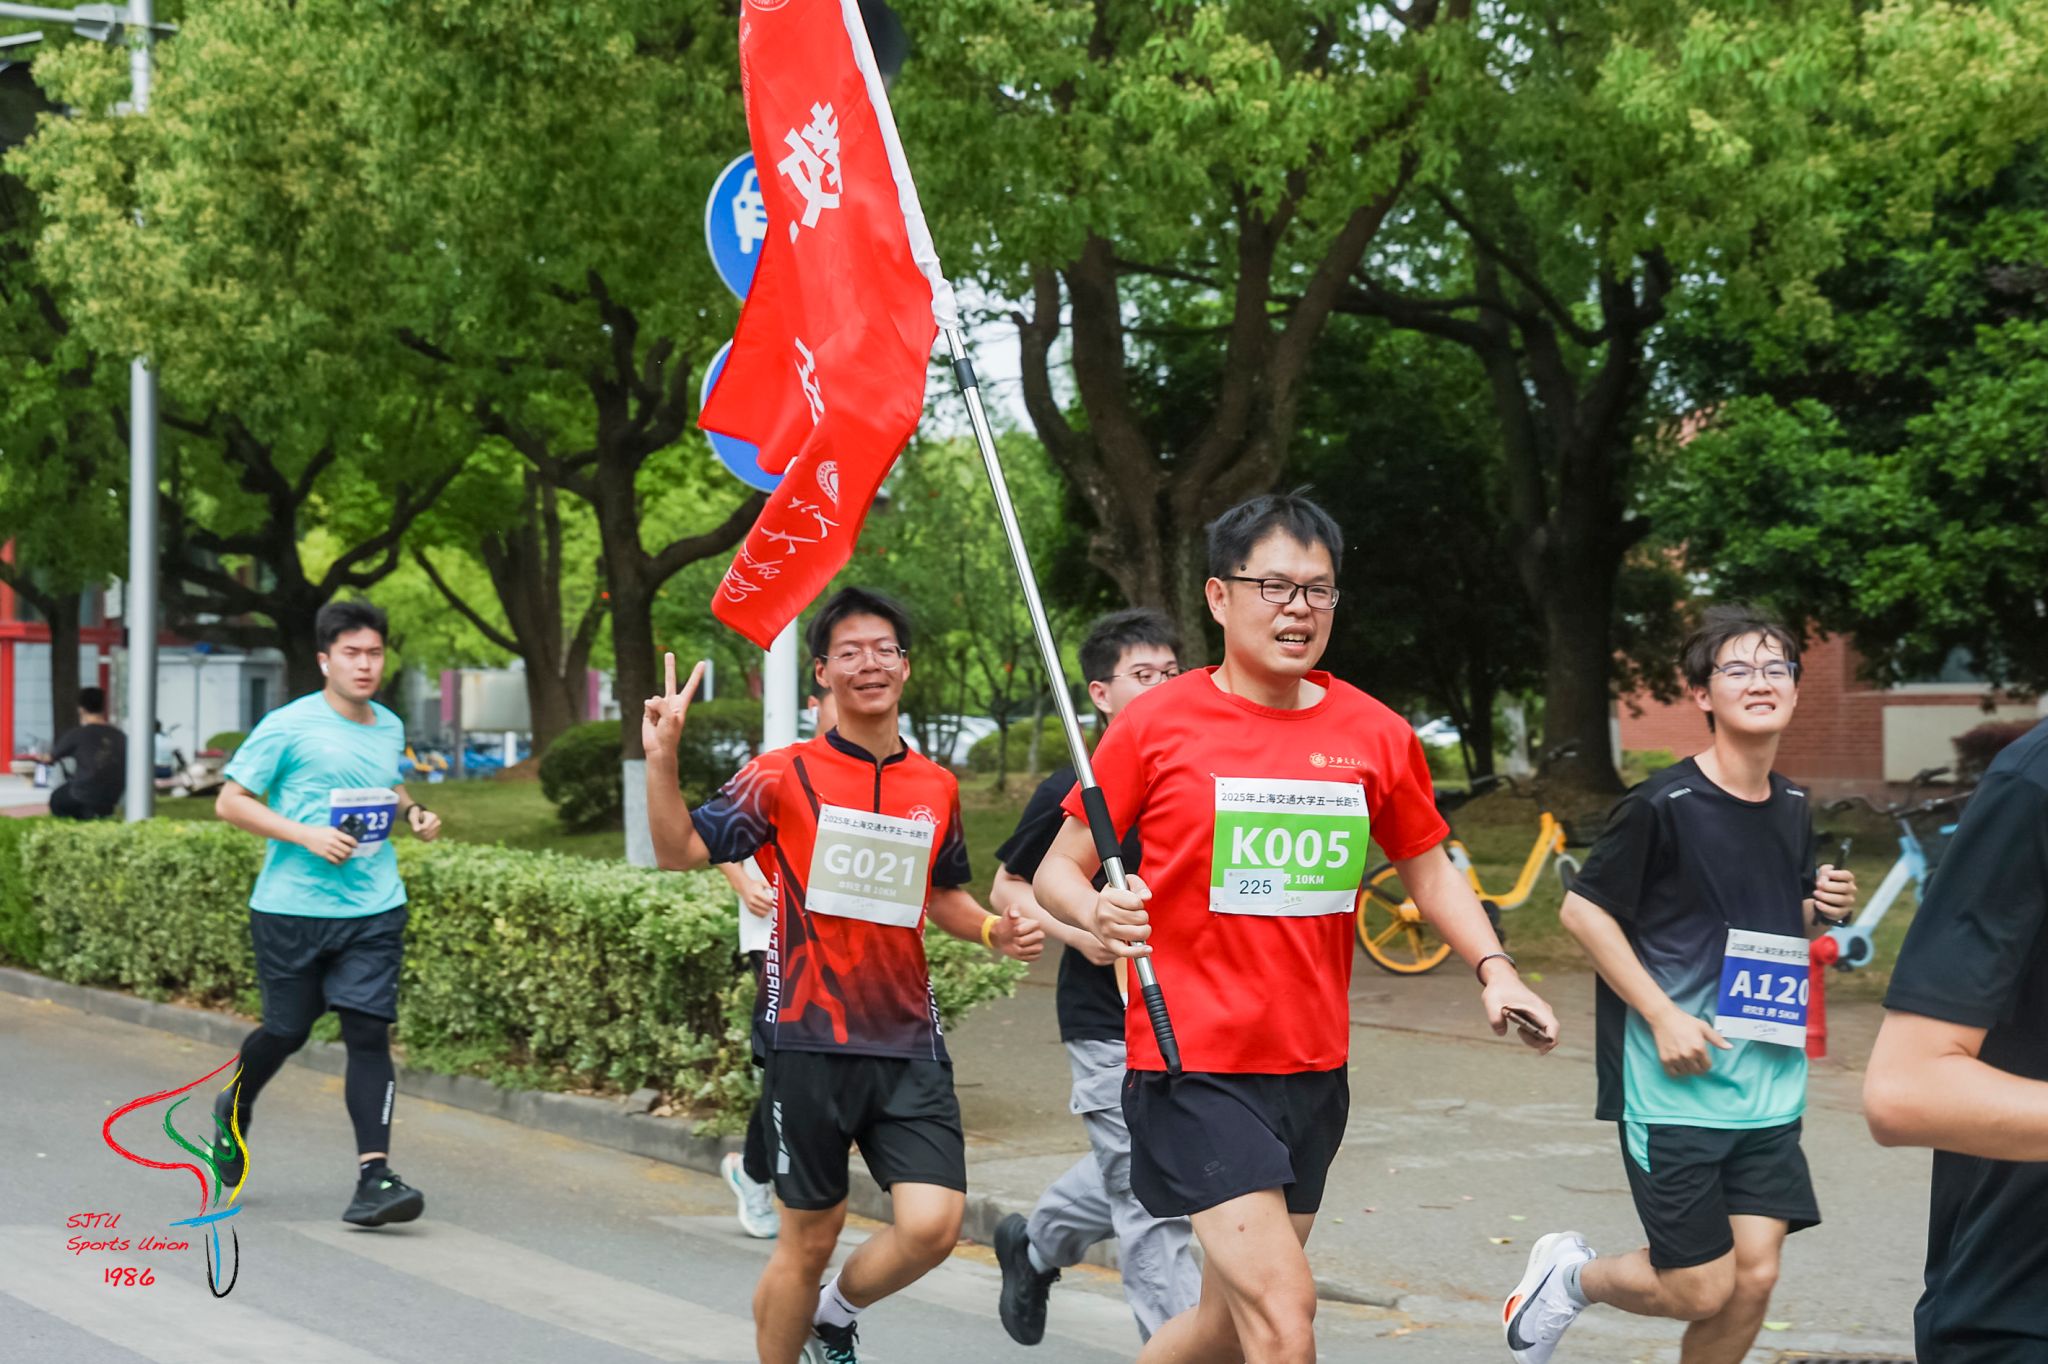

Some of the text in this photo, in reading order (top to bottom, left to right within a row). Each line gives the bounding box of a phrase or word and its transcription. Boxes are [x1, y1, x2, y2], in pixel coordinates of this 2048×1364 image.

[1221, 793, 1359, 807] 2025年上海交通大学五一长跑节
[340, 811, 389, 831] 23
[823, 813, 929, 840] 2025年上海交通大学五一长跑节
[1231, 826, 1350, 868] K005
[823, 843, 916, 887] G021
[1239, 879, 1272, 895] 225
[1295, 874, 1325, 885] 10KM
[1728, 969, 1809, 1006] A120
